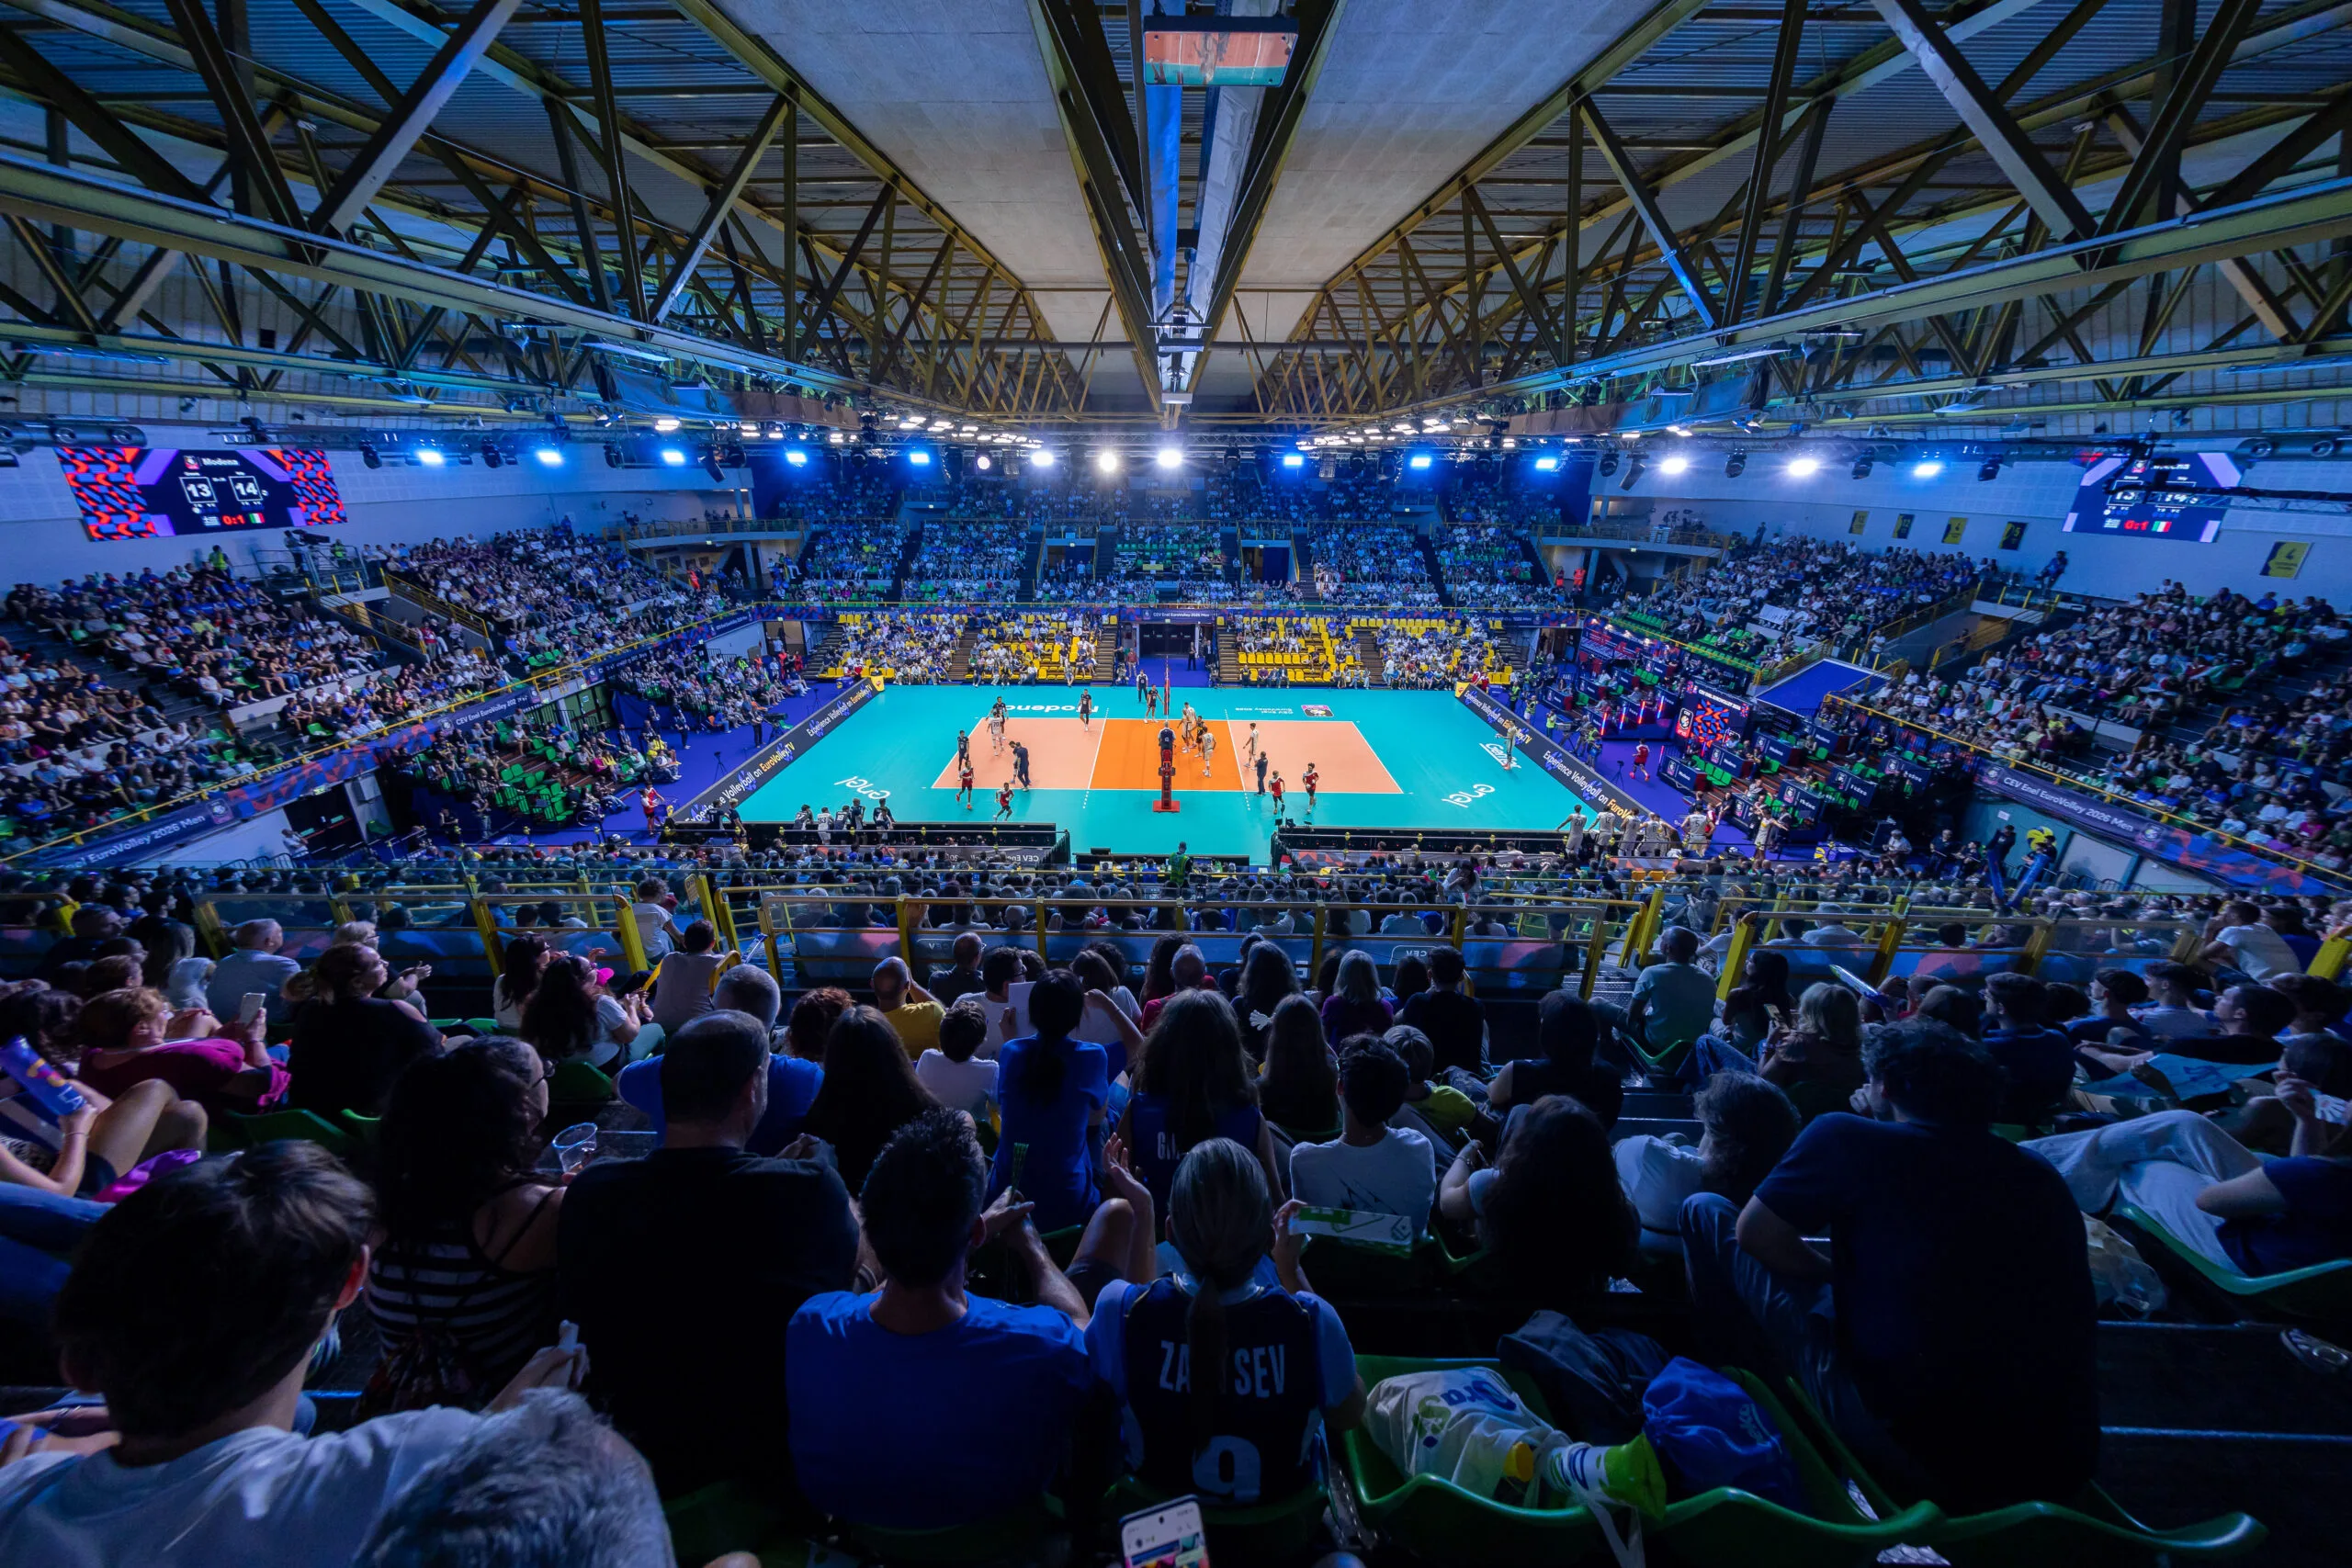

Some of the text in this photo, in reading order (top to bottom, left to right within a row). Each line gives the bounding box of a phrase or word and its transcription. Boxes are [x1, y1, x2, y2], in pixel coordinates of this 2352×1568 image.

[187, 483, 212, 497] 13
[234, 482, 258, 496] 14
[221, 514, 245, 525] 0:1
[2123, 520, 2149, 531] 0:1
[456, 717, 468, 726] CEV
[722, 772, 755, 800] Volleyball
[753, 768, 763, 778] on
[759, 741, 796, 773] EuroVolley.TV
[1544, 750, 1609, 805] Experience Volleyball on
[834, 775, 891, 799] enel
[1441, 784, 1496, 808] enel
[2003, 777, 2134, 832] CEV Enel EuroVolley 2026 Men
[89, 835, 152, 863] EuroVolley
[153, 823, 181, 840] 2026
[182, 814, 206, 829] Men
[1159, 1339, 1285, 1398] ZASEV
[1192, 1435, 1261, 1506] 9
